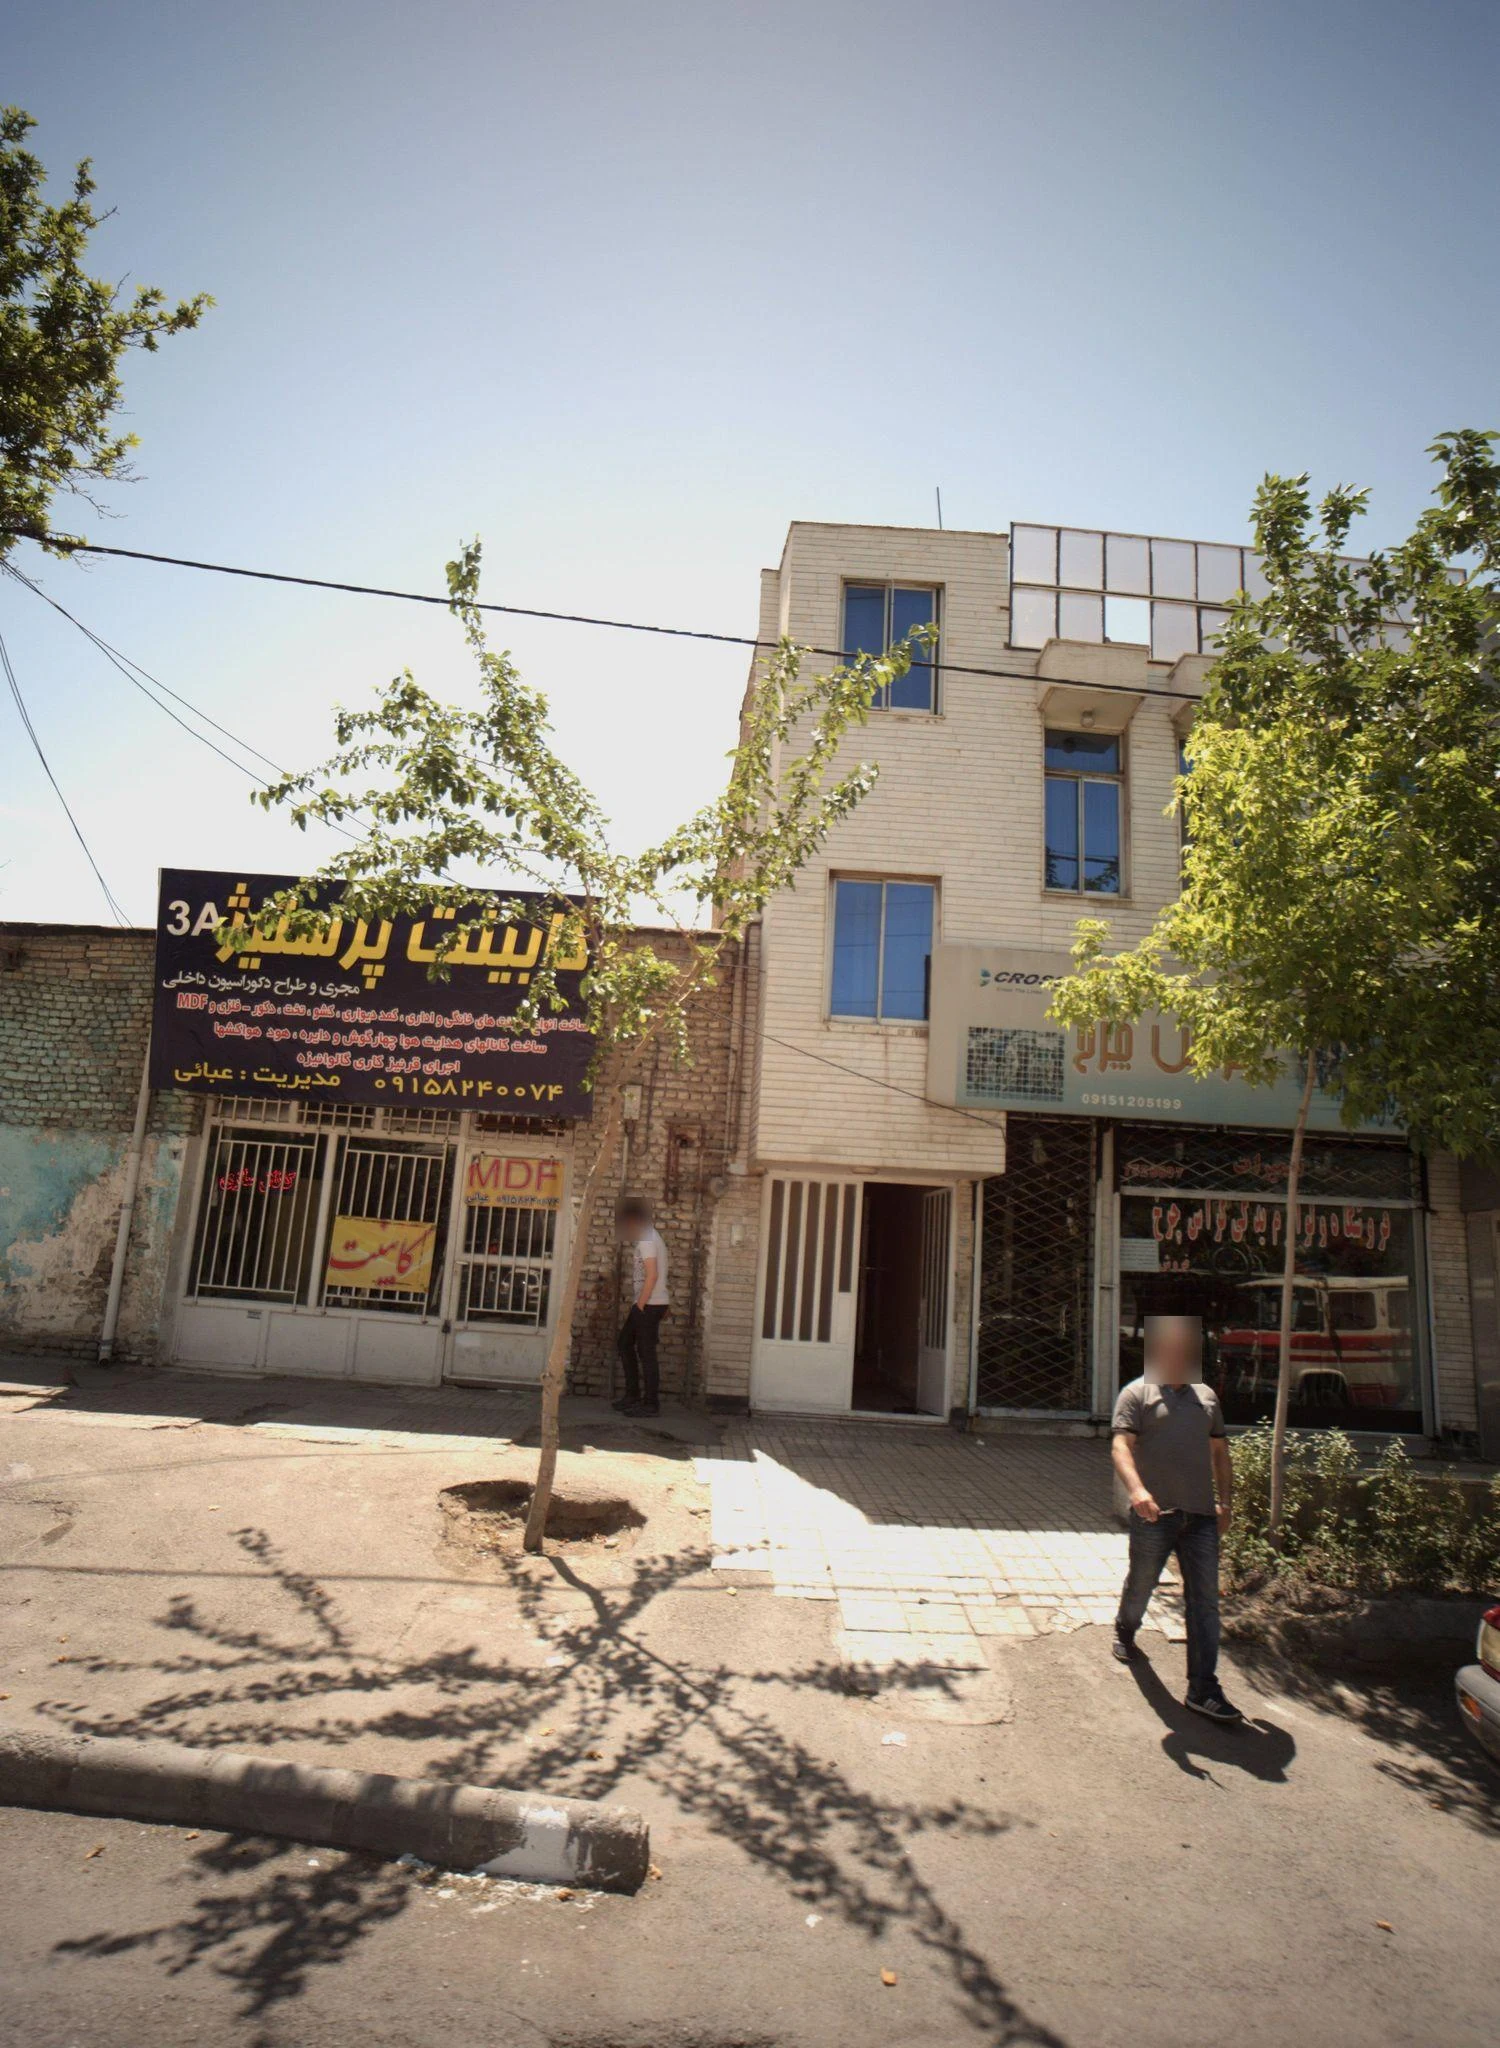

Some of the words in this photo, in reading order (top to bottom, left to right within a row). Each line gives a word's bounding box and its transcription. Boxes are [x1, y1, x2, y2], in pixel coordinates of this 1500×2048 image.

[166, 900, 221, 937] 3A
[215, 883, 393, 990] پرستیژ
[162, 970, 207, 988] داخلی
[208, 973, 272, 994] دکوراسیون
[274, 975, 307, 995] طراح
[309, 982, 317, 995] و
[319, 981, 360, 998] مجری
[176, 992, 208, 1010] MDF
[209, 1001, 217, 1014] و
[217, 999, 241, 1015] فلزی
[435, 1015, 443, 1028] و
[444, 1010, 474, 1029] خانگی
[474, 1013, 495, 1030] های
[266, 1027, 290, 1041] هود
[332, 1034, 340, 1046] و
[400, 1034, 420, 1049] هوا
[422, 1034, 463, 1051] هدایت
[465, 1037, 509, 1053] کانالهای
[511, 1039, 547, 1054] ساخت
[297, 1050, 351, 1068] گالوانیزه
[353, 1053, 384, 1071] کاری
[386, 1055, 421, 1073] قرنیز
[423, 1059, 460, 1076] اجرای
[252, 1066, 341, 1089] مدیریت
[374, 1077, 564, 1102] ۰۹۱۵۸۲۴۰۰۷۴
[1081, 1093, 1183, 1110] 09151205199
[468, 1157, 560, 1190] MDF
[1272, 1202, 1316, 1248] لوام
[330, 1221, 435, 1287] کابینت
